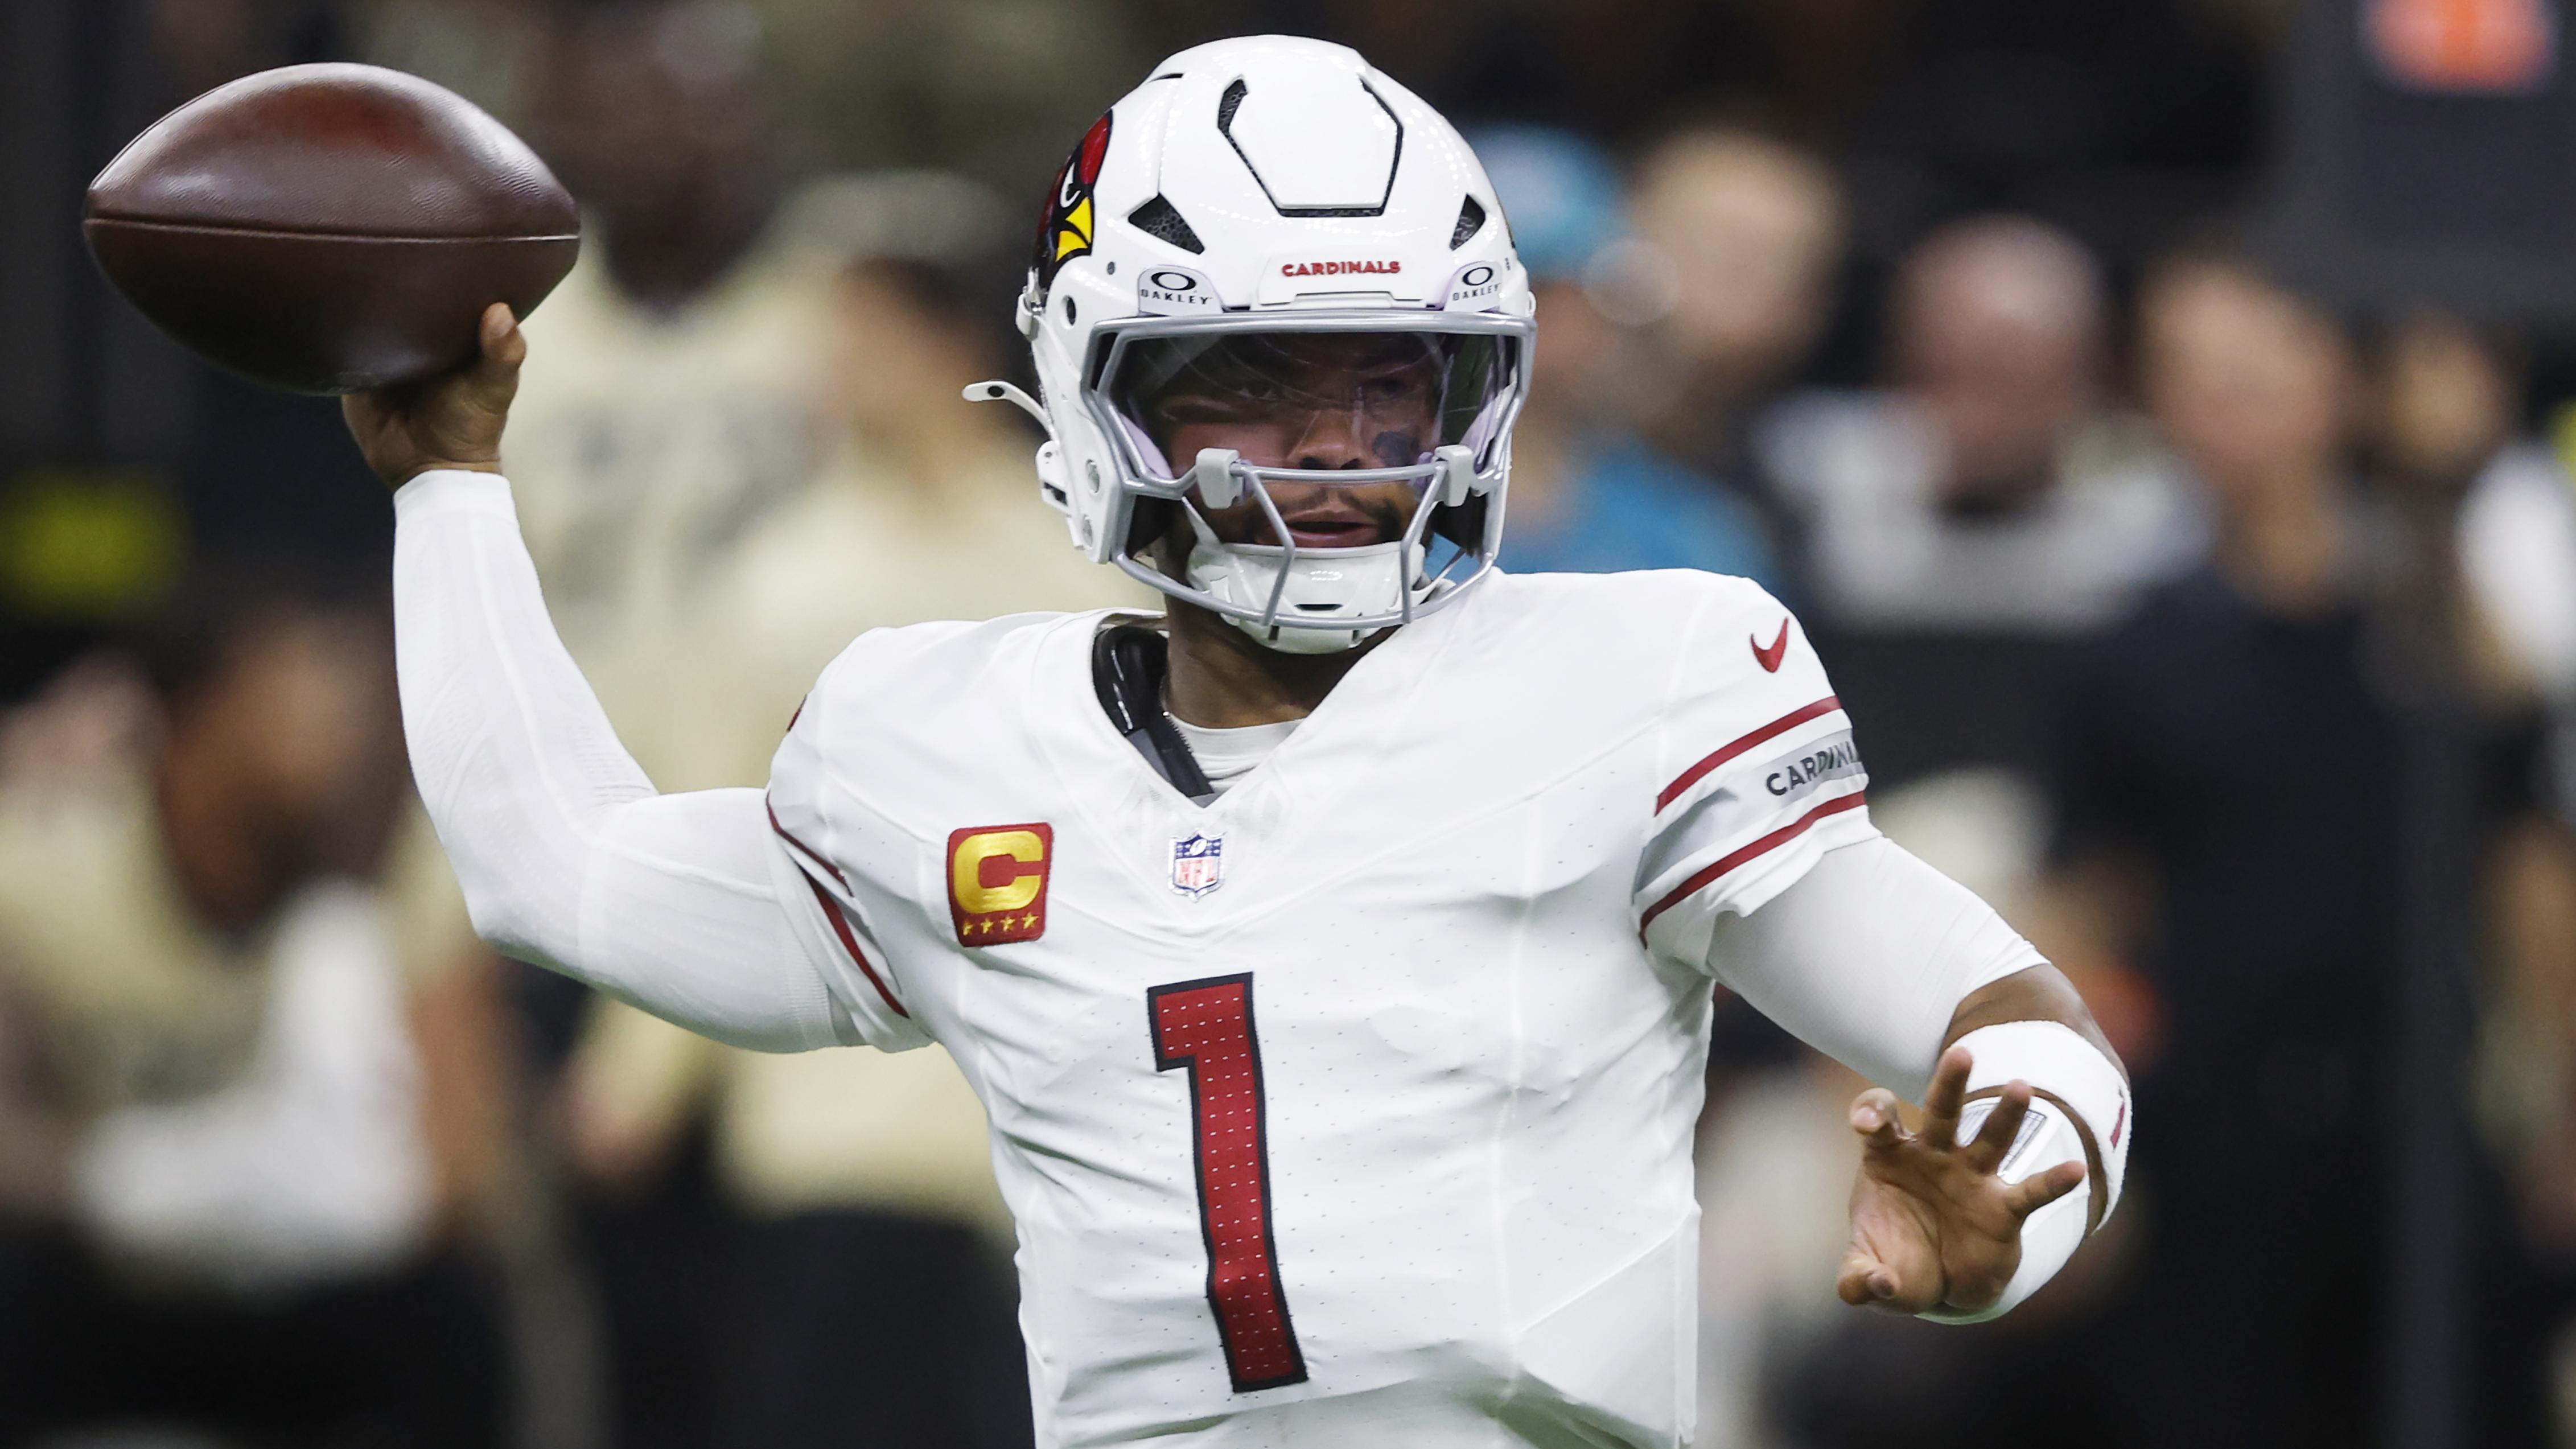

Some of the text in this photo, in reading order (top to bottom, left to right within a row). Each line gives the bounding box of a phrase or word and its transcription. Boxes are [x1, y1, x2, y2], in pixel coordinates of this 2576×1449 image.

[1282, 261, 1400, 277] CARDINALS
[1141, 289, 1209, 304] OAKLEY
[1452, 284, 1499, 300] OAKLEY
[953, 830, 1043, 914] C
[1177, 858, 1219, 886] NFL
[1147, 972, 1308, 1393] 1
